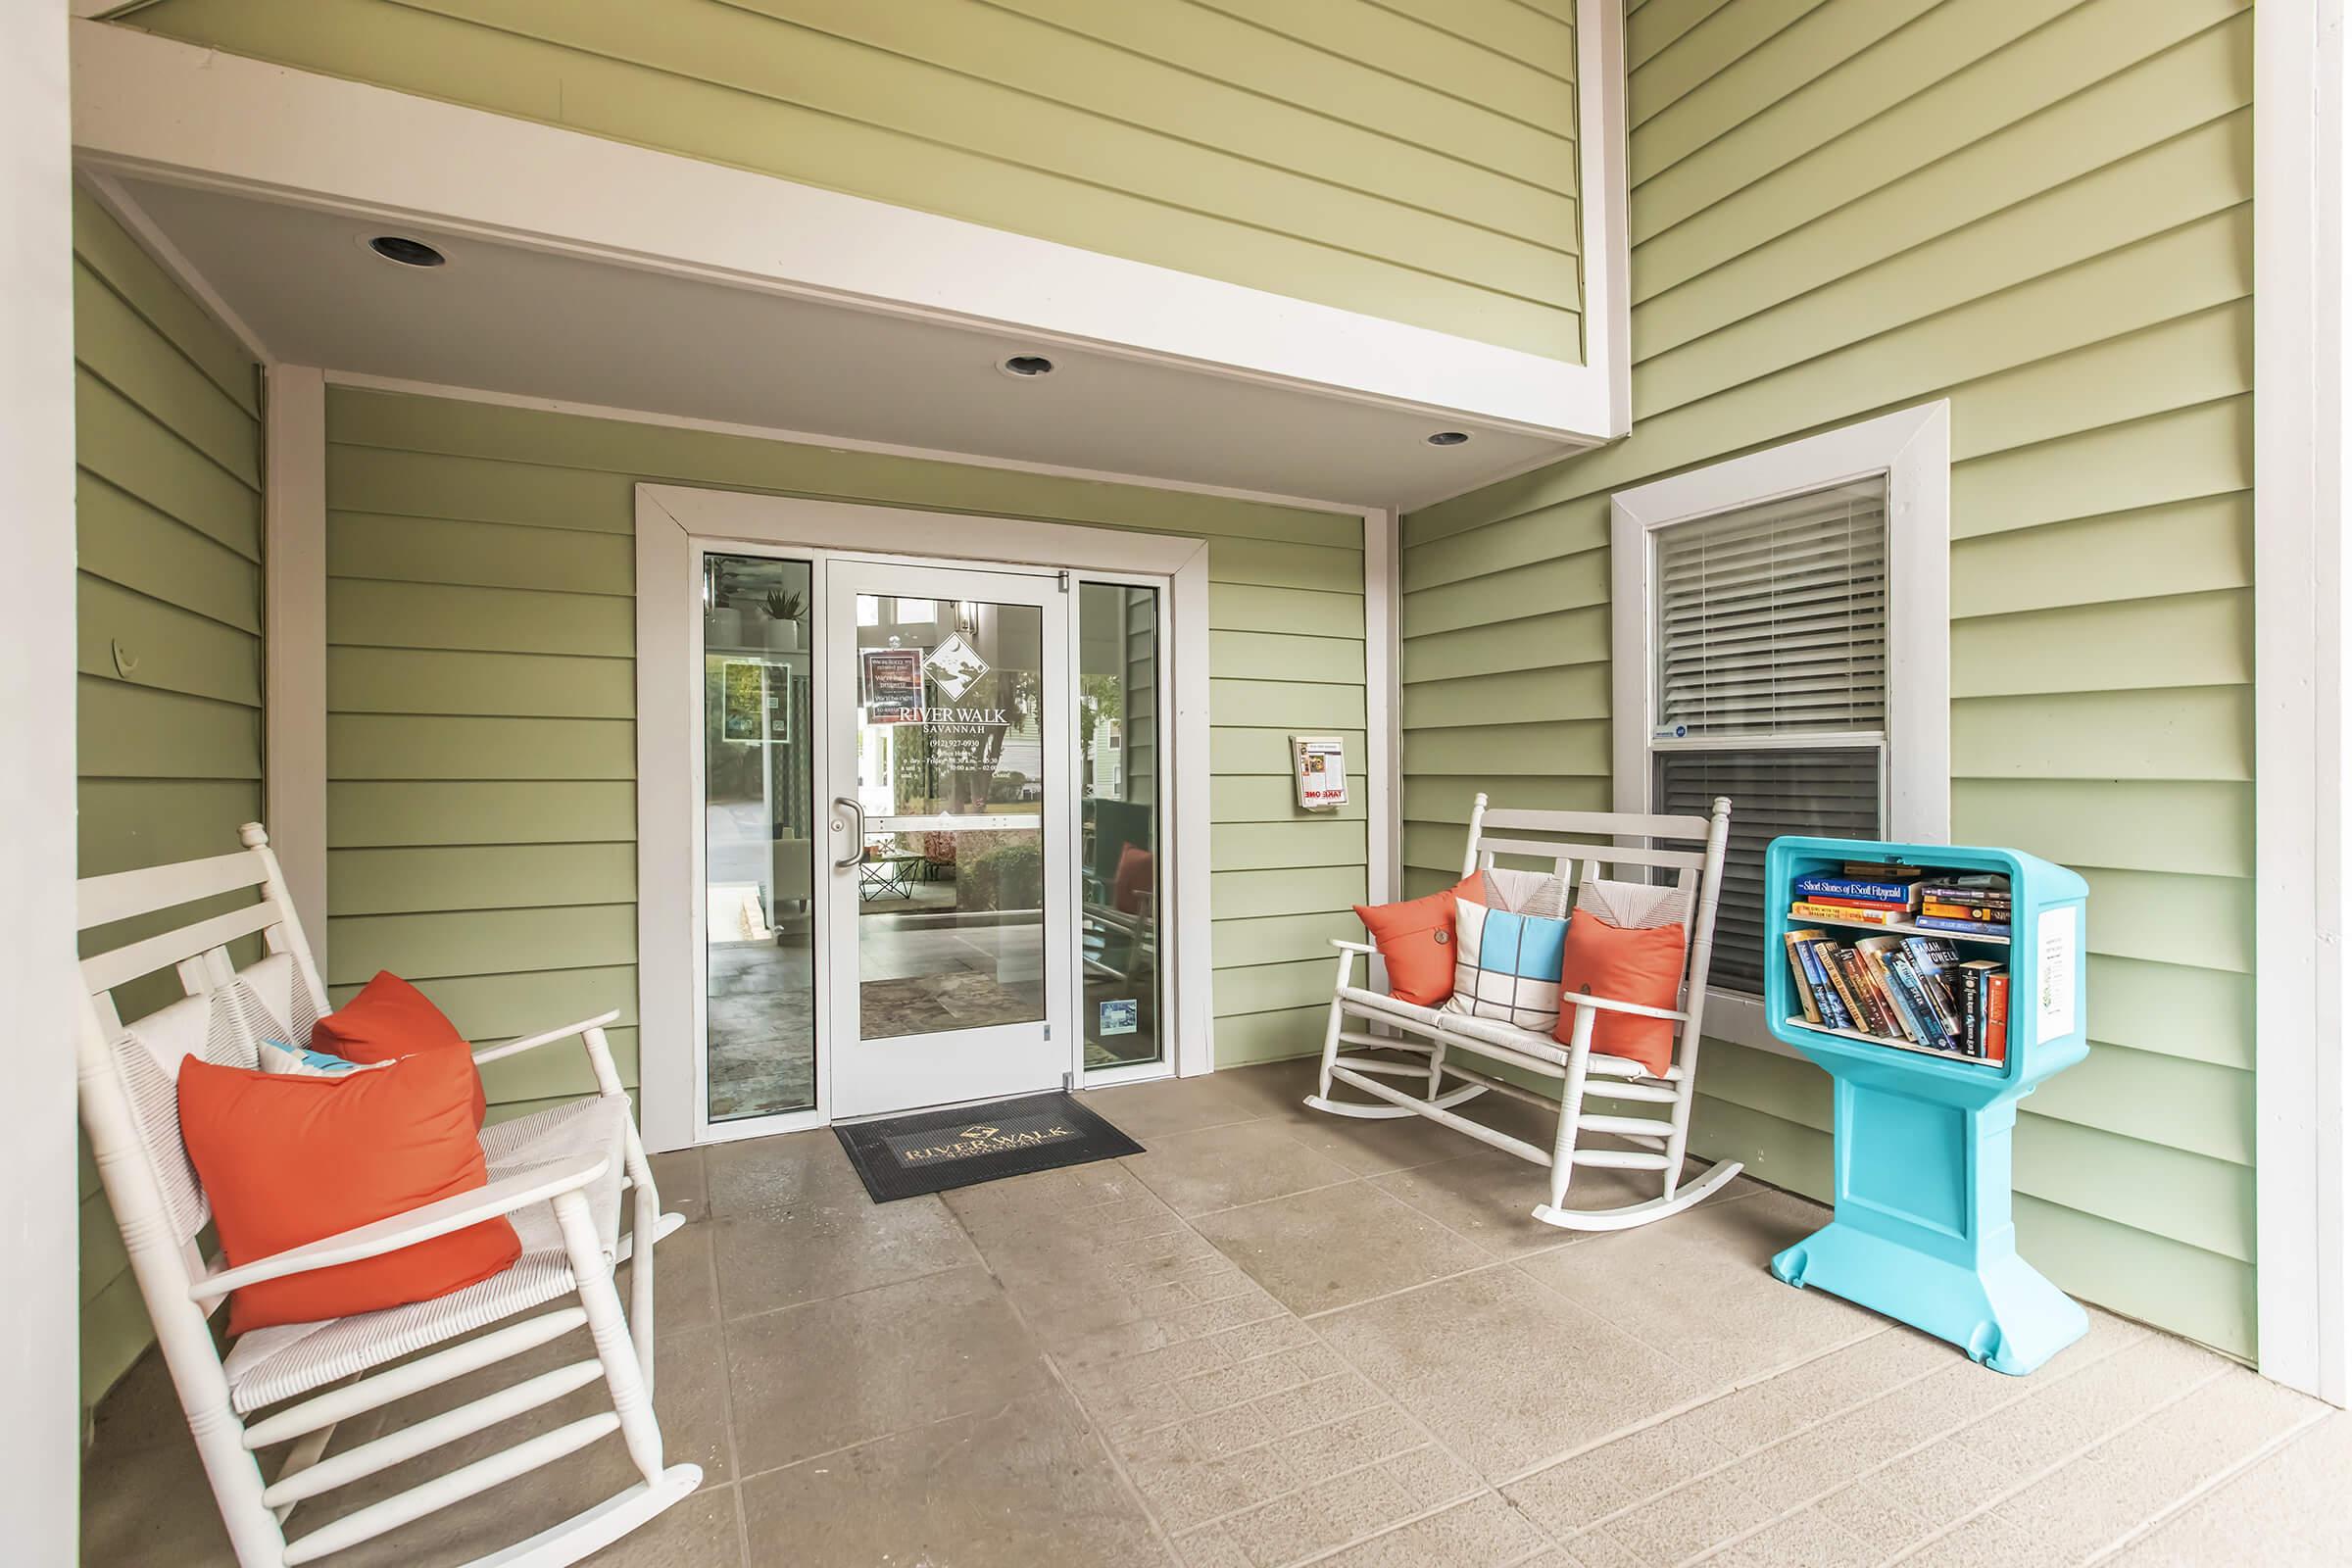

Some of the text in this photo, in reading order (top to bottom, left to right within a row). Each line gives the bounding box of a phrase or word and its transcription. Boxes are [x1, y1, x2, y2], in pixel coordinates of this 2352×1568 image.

[899, 707, 1007, 723] RIVER WALK
[922, 724, 985, 734] SAVANNAH
[1803, 880, 1821, 892] Short
[1821, 882, 1842, 893] Stories
[1842, 883, 1850, 895] of
[1872, 885, 1900, 901] Fitzgerald
[1912, 941, 1940, 953] SARAH
[904, 1126, 1072, 1161] RIVER WALK
